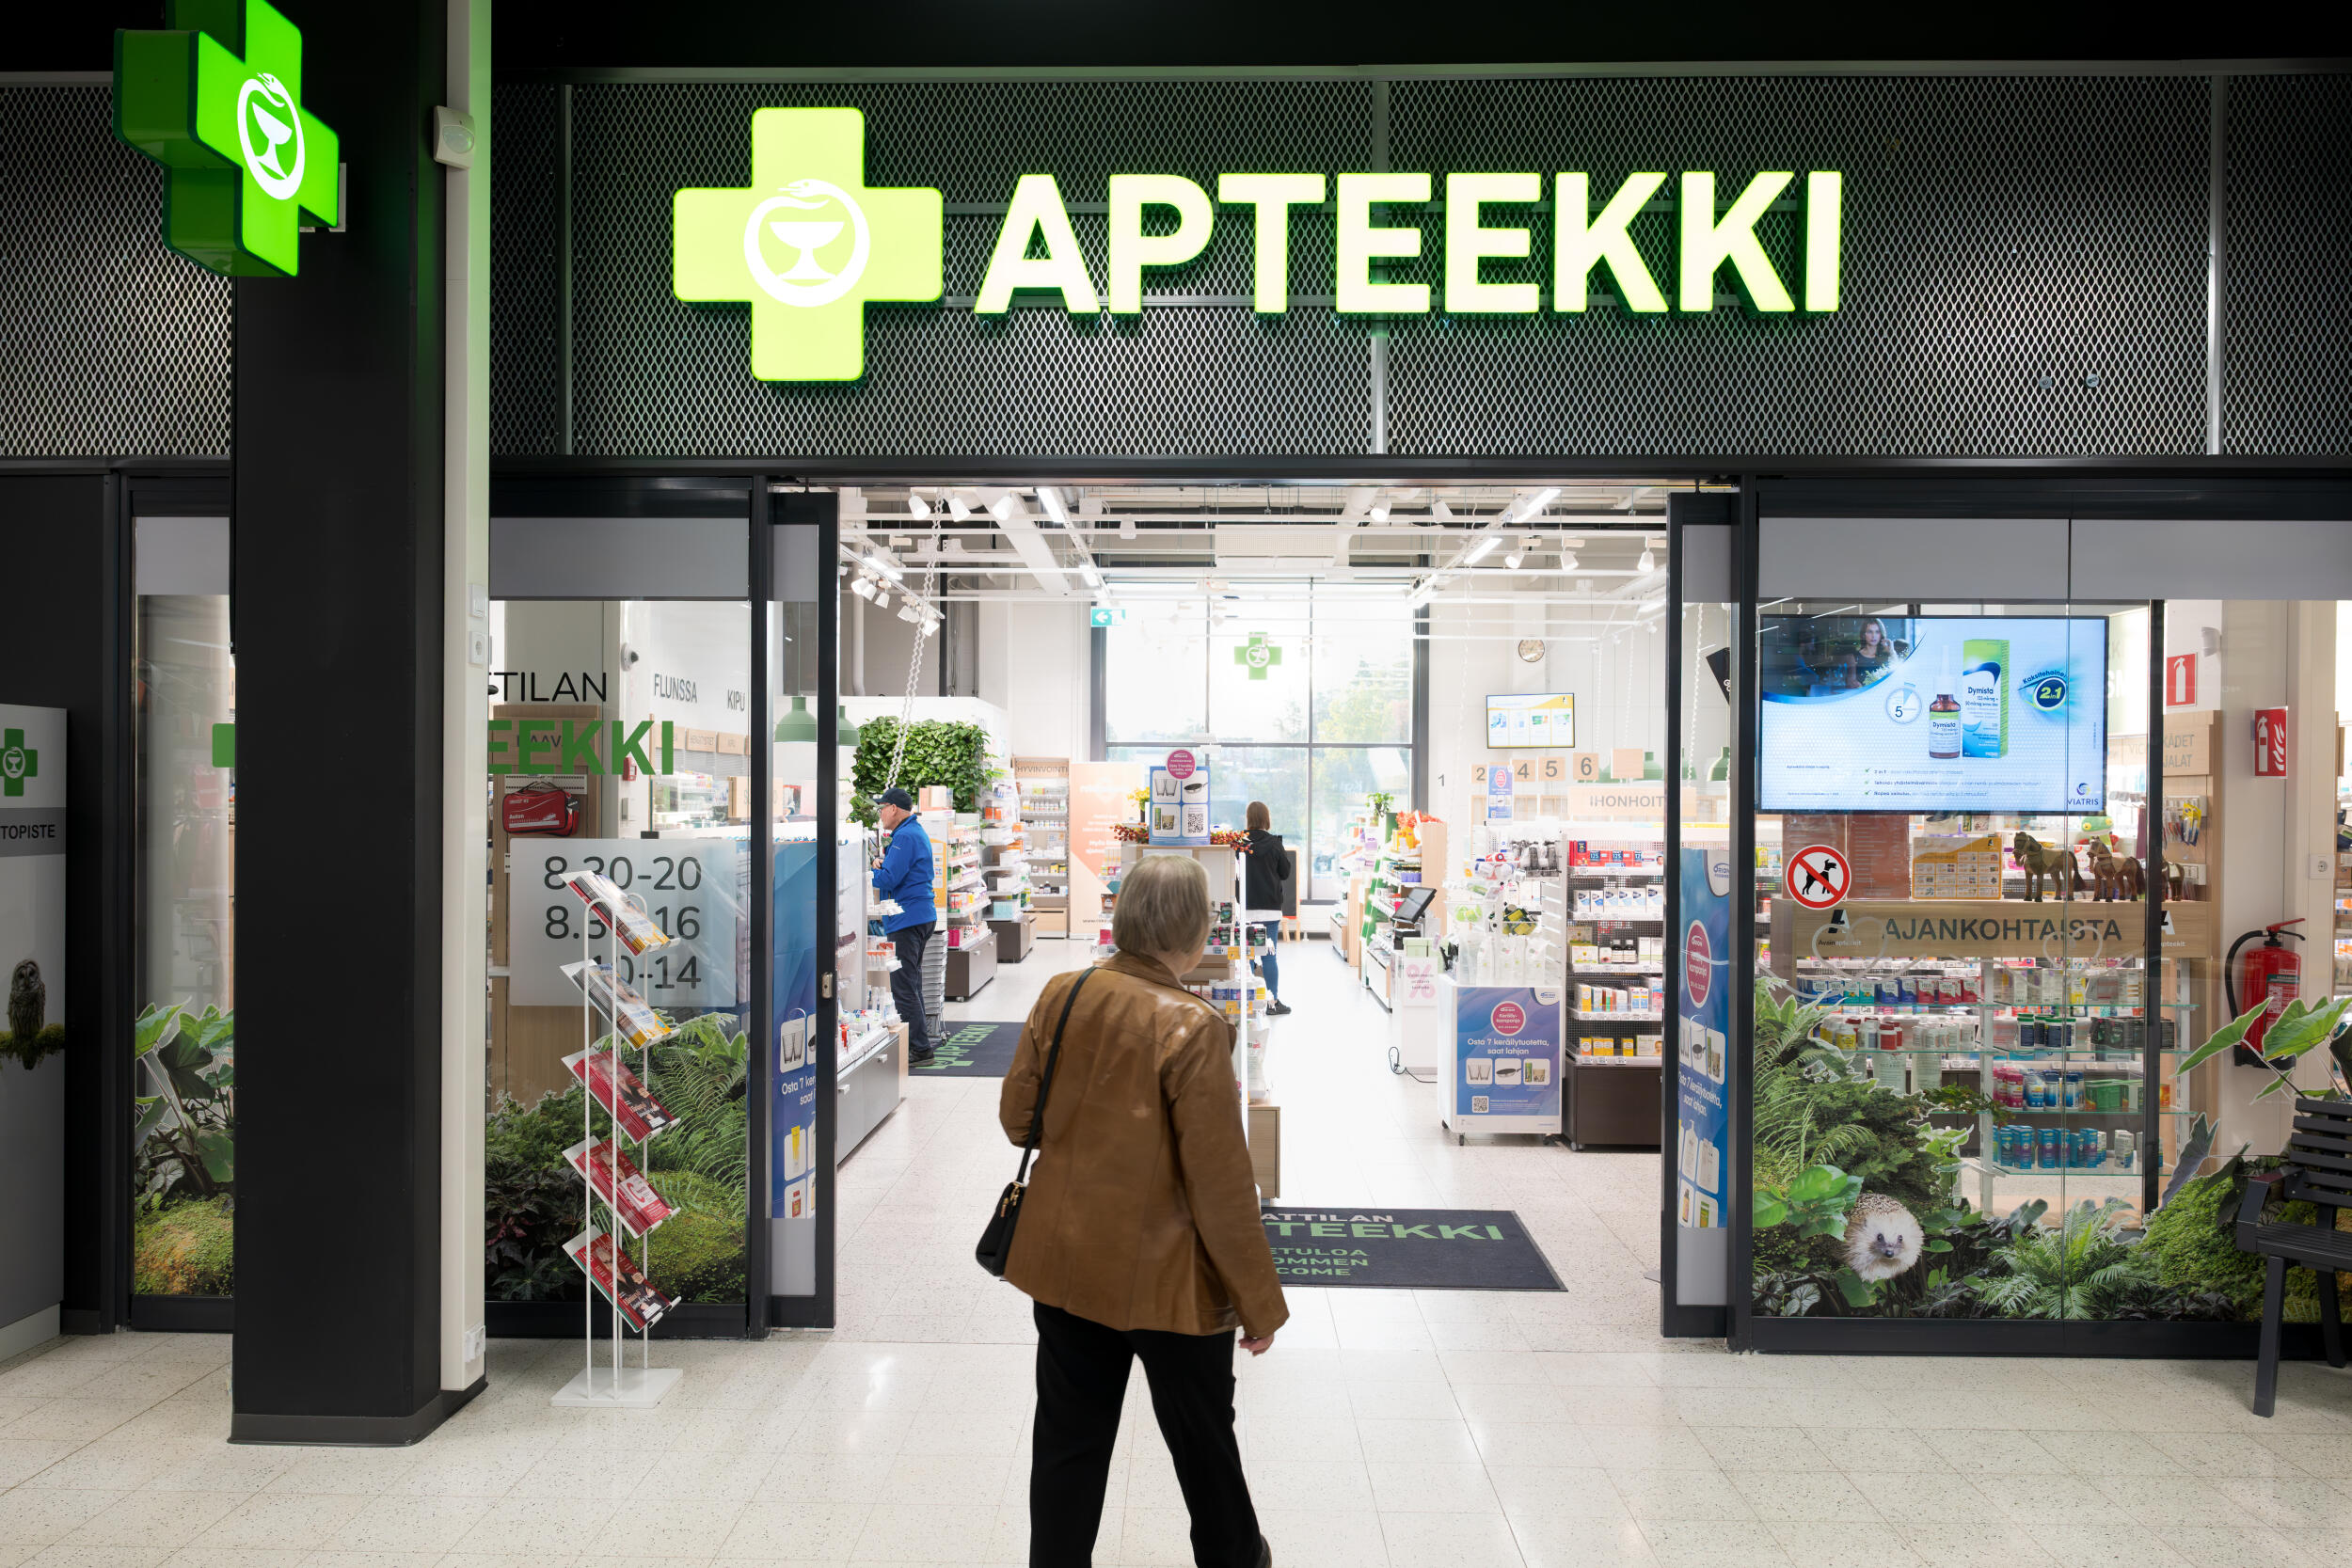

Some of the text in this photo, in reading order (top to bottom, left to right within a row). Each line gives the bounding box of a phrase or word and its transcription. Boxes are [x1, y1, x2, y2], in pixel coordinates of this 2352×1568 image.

[973, 170, 1842, 314] APTEEKKI
[2023, 670, 2067, 685] Kaksitehoine
[489, 671, 608, 703] TILAN
[654, 673, 698, 705] FLUNSSA
[1967, 686, 1994, 696] Dymista
[726, 689, 746, 712] KIPU
[1895, 705, 1903, 718] 5
[1475, 767, 1486, 781] 2
[1517, 763, 1530, 780] 4
[1545, 760, 1558, 778] 5
[1580, 756, 1594, 776] 6
[1438, 773, 1446, 788] 1
[0, 824, 56, 840] TOPISTE
[543, 855, 702, 891] 830-20
[1883, 917, 2122, 942] AJANKOHTAISTA
[1467, 1037, 1486, 1046] Osta
[1505, 1046, 1530, 1056] lahjan
[782, 1081, 799, 1096] Osta
[799, 1078, 804, 1089] 7
[800, 1092, 813, 1106] saat
[1264, 1221, 1506, 1241] TEEKKI
